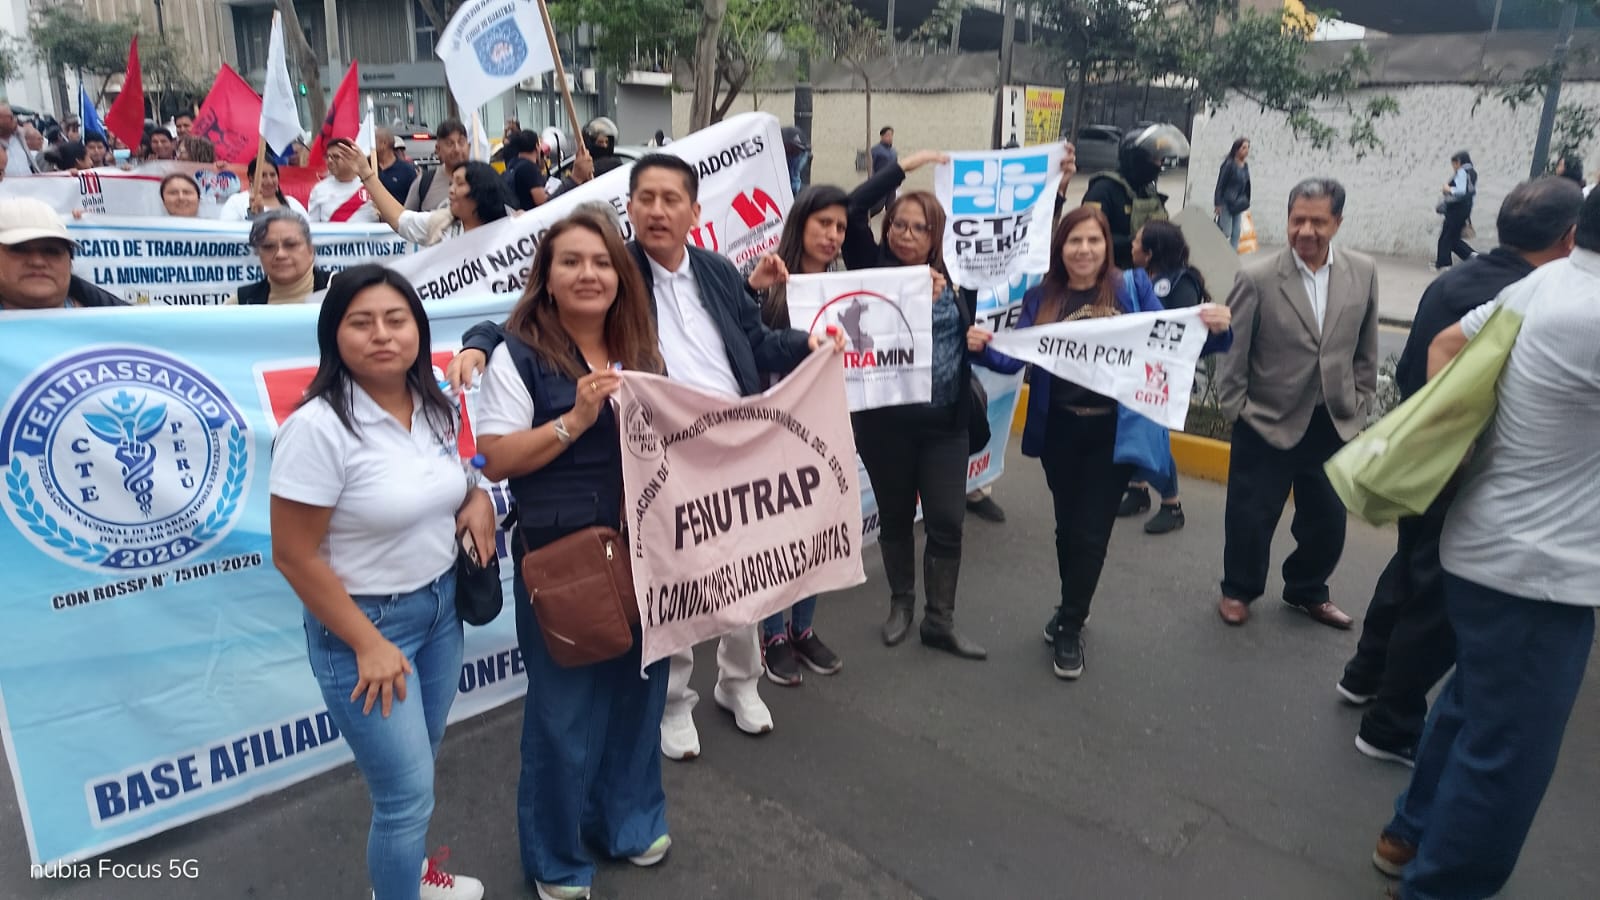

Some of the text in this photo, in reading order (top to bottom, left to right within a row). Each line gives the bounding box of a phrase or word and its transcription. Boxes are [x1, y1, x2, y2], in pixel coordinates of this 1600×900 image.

[123, 240, 142, 256] DE
[145, 240, 249, 257] TRABAJADORES
[393, 241, 407, 255] DE
[94, 267, 113, 284] LA
[117, 266, 224, 284] MUNICIPALIDAD
[227, 266, 243, 281] DE
[1038, 335, 1133, 367] SITRA PCM
[21, 361, 221, 443] FENTRASSALUD
[675, 465, 820, 551] FENUTRAP
[99, 518, 199, 545] DEL SECTOR SALUD
[132, 528, 146, 536] DE
[121, 539, 184, 567] 2026
[53, 592, 89, 610] CON
[93, 576, 148, 602] ROSSP
[173, 552, 262, 583] 75101-2026
[658, 562, 736, 625] CONDICIONES
[735, 540, 806, 601] LABORALES
[809, 522, 850, 569] JUSTAS
[93, 754, 202, 821] BASE
